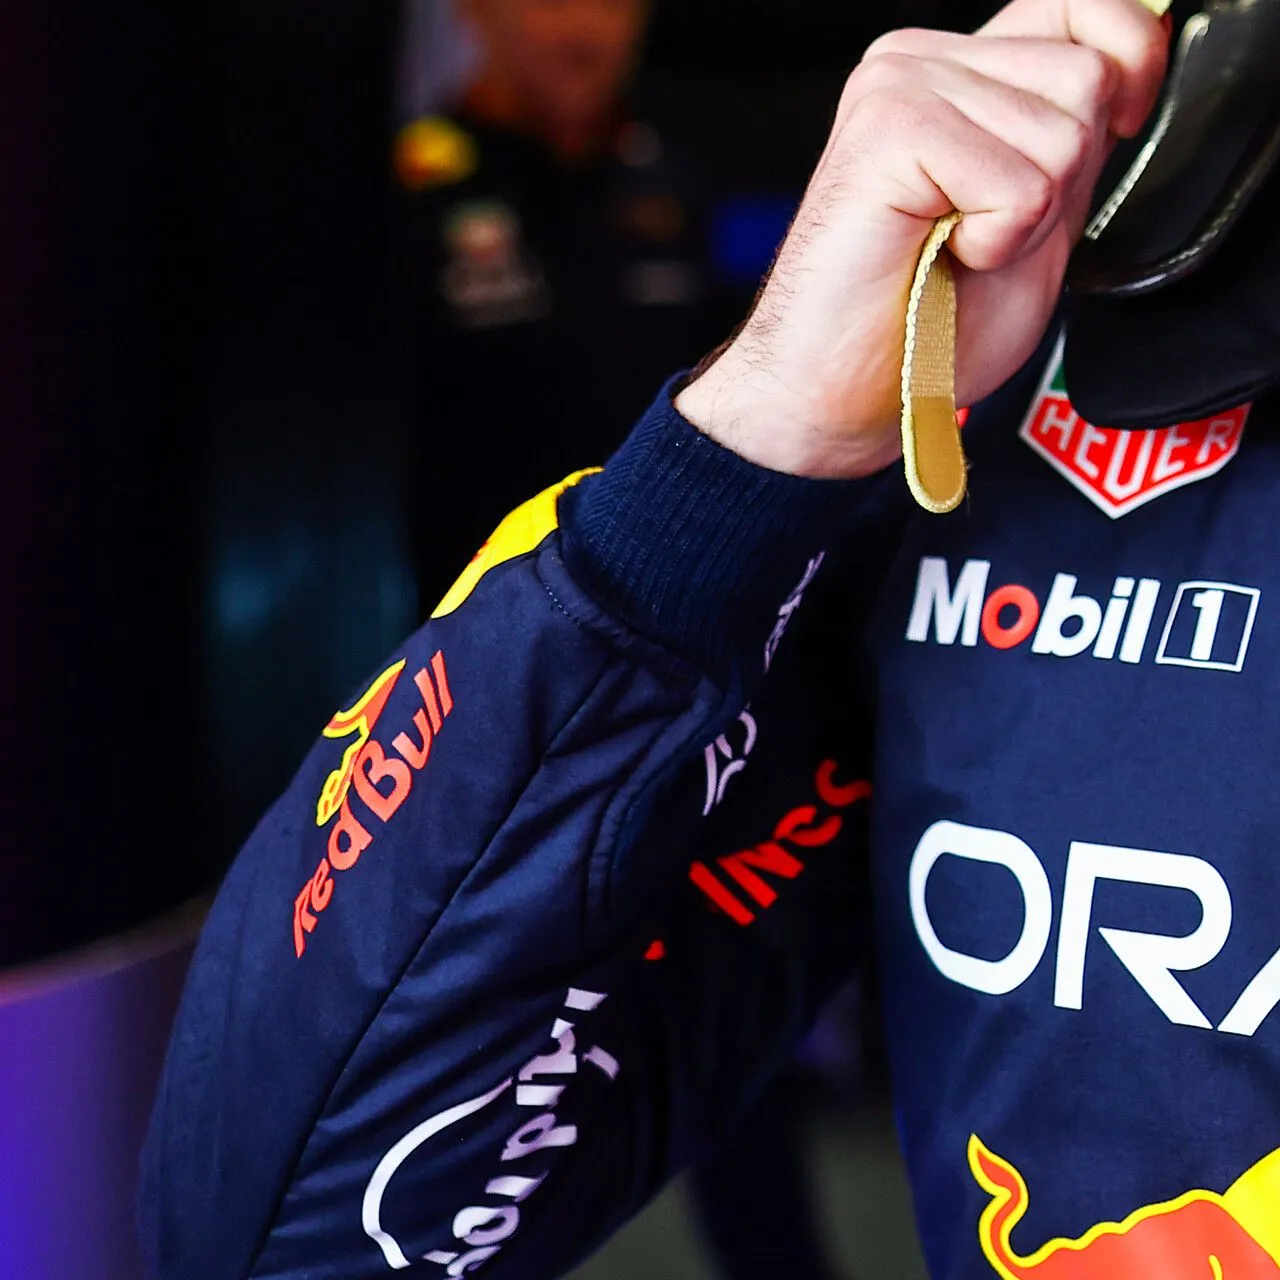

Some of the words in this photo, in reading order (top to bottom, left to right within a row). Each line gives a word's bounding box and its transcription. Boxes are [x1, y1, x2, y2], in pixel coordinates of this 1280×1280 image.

[1040, 403, 1236, 502] HEUER
[906, 556, 1161, 664] Mobil
[352, 649, 454, 823] Bull
